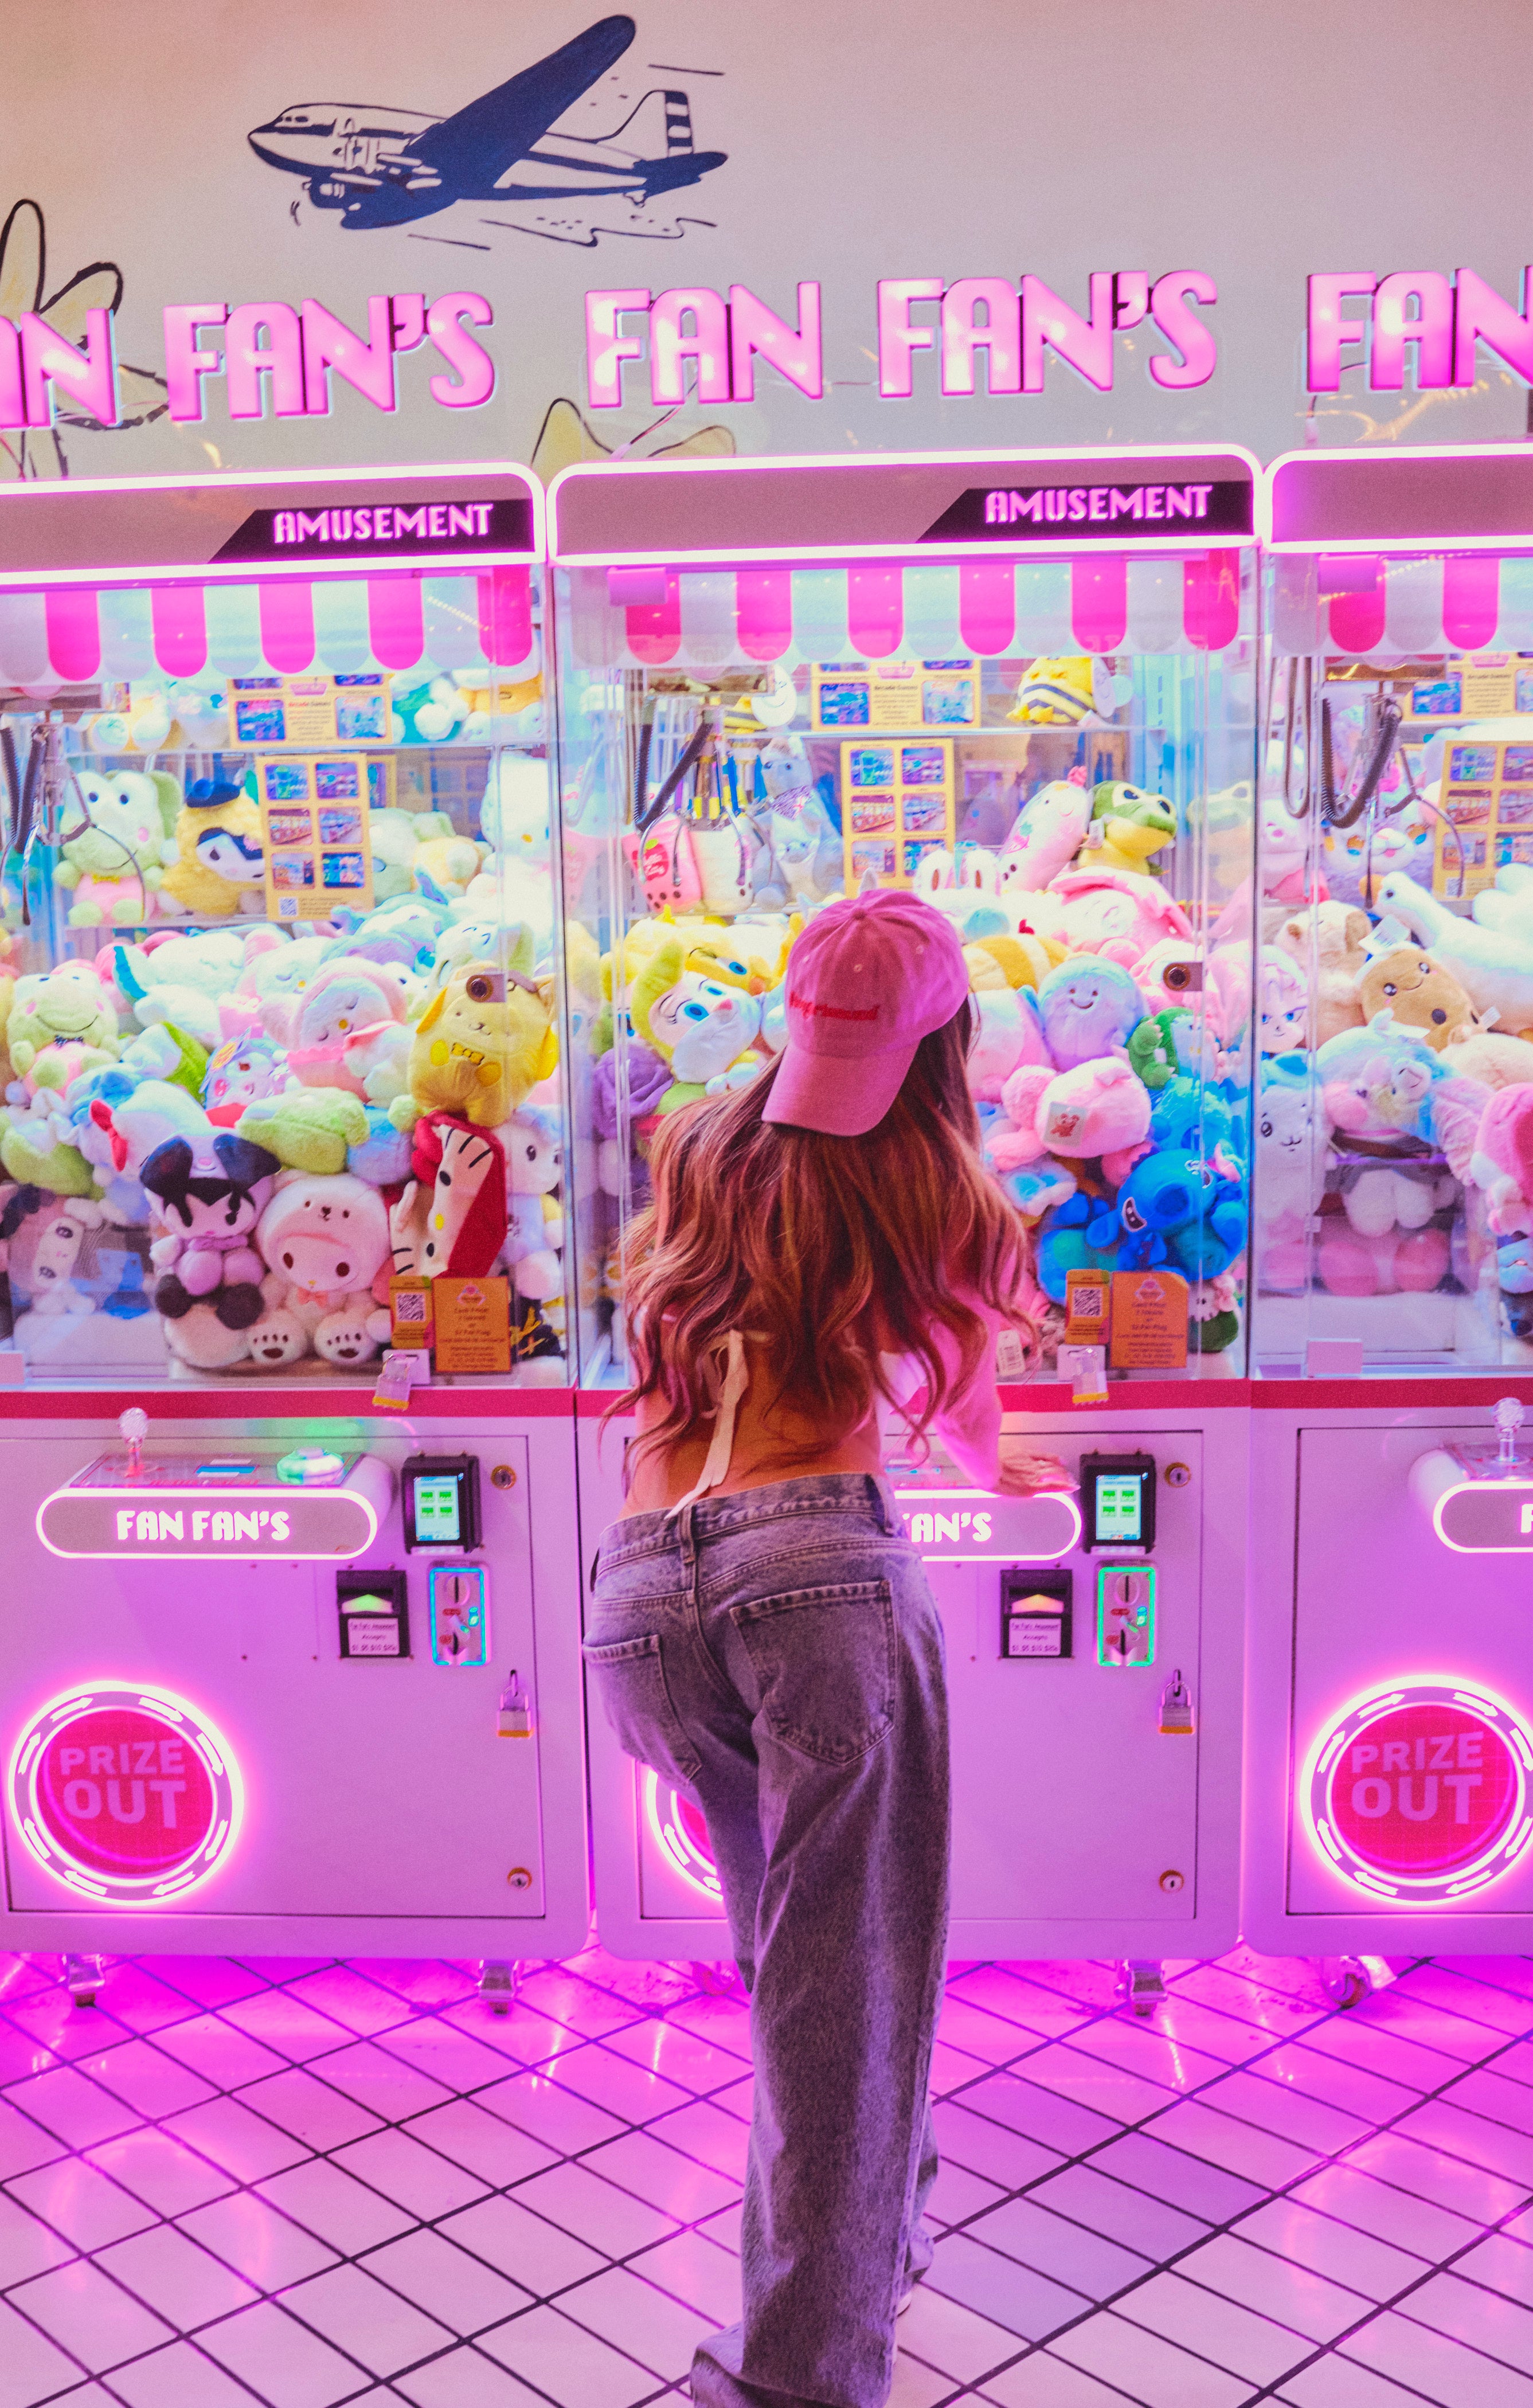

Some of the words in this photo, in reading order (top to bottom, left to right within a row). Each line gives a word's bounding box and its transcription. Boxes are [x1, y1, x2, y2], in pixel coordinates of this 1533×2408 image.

[585, 280, 823, 409] FAN
[877, 270, 1218, 398] FAN'S
[1307, 265, 1533, 394] FAN
[0, 308, 115, 428] N
[163, 292, 495, 421] FAN'S
[273, 503, 494, 544] AMUSEMENT
[985, 484, 1214, 524] AMUSEMENT
[116, 1510, 185, 1541] FAN
[191, 1510, 290, 1541] FAN'S
[902, 1512, 992, 1543] AN'S
[60, 1739, 186, 1776] PRIZE
[1351, 1731, 1484, 1773] PRIZE
[62, 1778, 186, 1828] OUT
[1351, 1774, 1483, 1824] OUT
